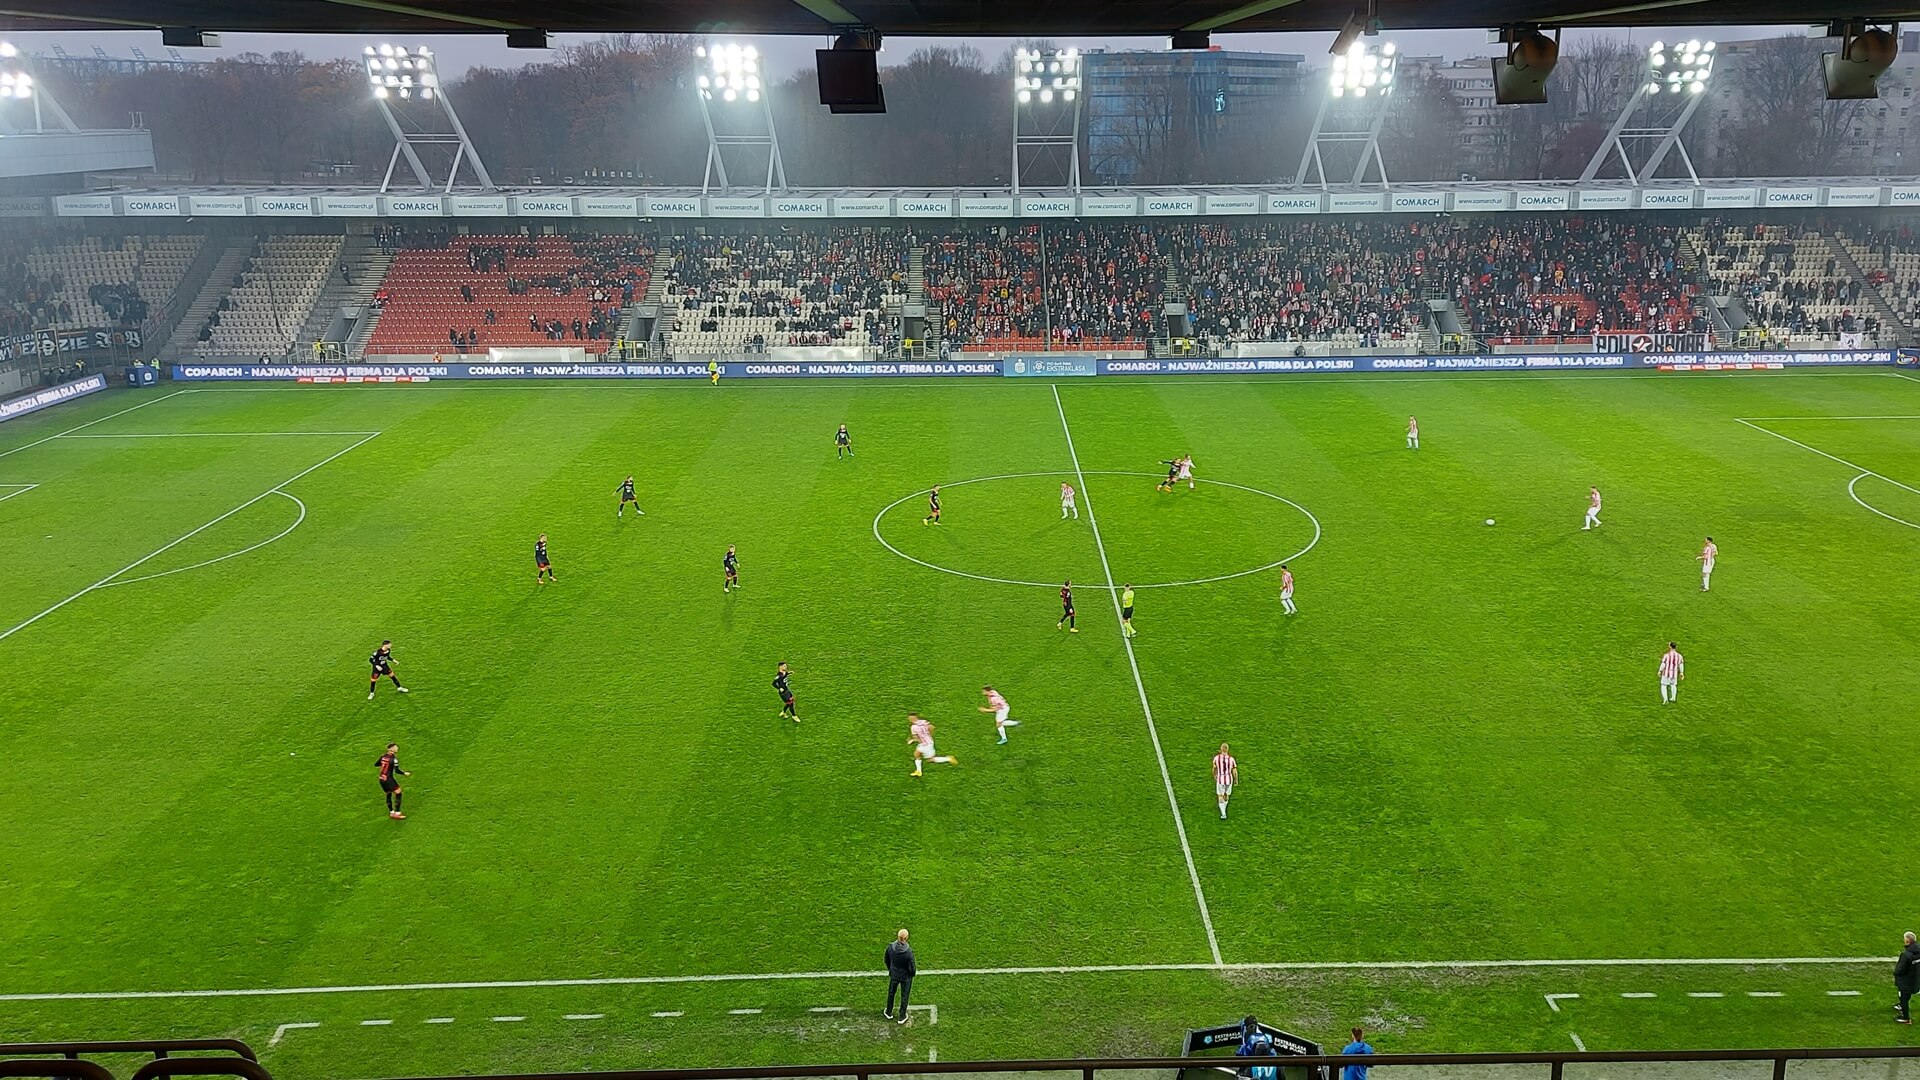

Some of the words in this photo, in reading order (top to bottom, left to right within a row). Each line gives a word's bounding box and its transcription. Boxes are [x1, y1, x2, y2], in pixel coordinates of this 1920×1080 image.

[1520, 196, 1564, 205] COMARCH
[1645, 195, 1689, 203] COMARCH
[1769, 193, 1813, 202] COMARCH
[1893, 192, 1920, 200] COMA
[130, 201, 177, 211] COMARCH
[262, 202, 308, 211] COMARCH
[392, 202, 439, 211] COMARCH
[522, 202, 568, 211] COMARCH
[1149, 202, 1193, 210] COMARCH
[1272, 200, 1316, 208] COMARCH
[1396, 198, 1439, 207] COMARCH
[651, 203, 696, 212] COMARCH
[777, 203, 822, 212] COMARCH
[903, 203, 947, 212] COMARCH
[1026, 203, 1070, 212] COMARCH
[1372, 359, 1428, 369] COMARCH
[1435, 356, 1524, 368] NAJWAŻNIEJSZA
[1526, 357, 1560, 367] FIRMA
[1560, 357, 1582, 366] DLA
[1584, 356, 1624, 366] POLSKI
[1643, 354, 1697, 364] COMARCH
[1705, 352, 1795, 364] NAJWAŻNIEJSZA
[1795, 353, 1830, 363] FIRMA
[1830, 353, 1853, 362] DLA
[745, 365, 800, 375] COMARCH
[808, 362, 898, 374] NAJWAŻNIEJSZA
[899, 364, 933, 374] FIRMA
[934, 364, 957, 374] DLA
[957, 364, 995, 373] POLSKI
[1107, 361, 1161, 371] COMARCH
[1168, 359, 1257, 371] NAJWAŻNIEJSZA
[1258, 360, 1293, 370] FIRMA
[1293, 360, 1315, 370] DLA
[1316, 359, 1354, 369] POLSKI
[184, 367, 242, 377] COMARCH
[251, 365, 345, 377] NAJWAŻNIEJSZA
[347, 367, 382, 377] FIRMA
[383, 367, 406, 376] DLA
[407, 366, 448, 376] POLSKI
[468, 366, 524, 376] COMARCH
[627, 366, 662, 376] FIRMA
[663, 366, 686, 375] DLA
